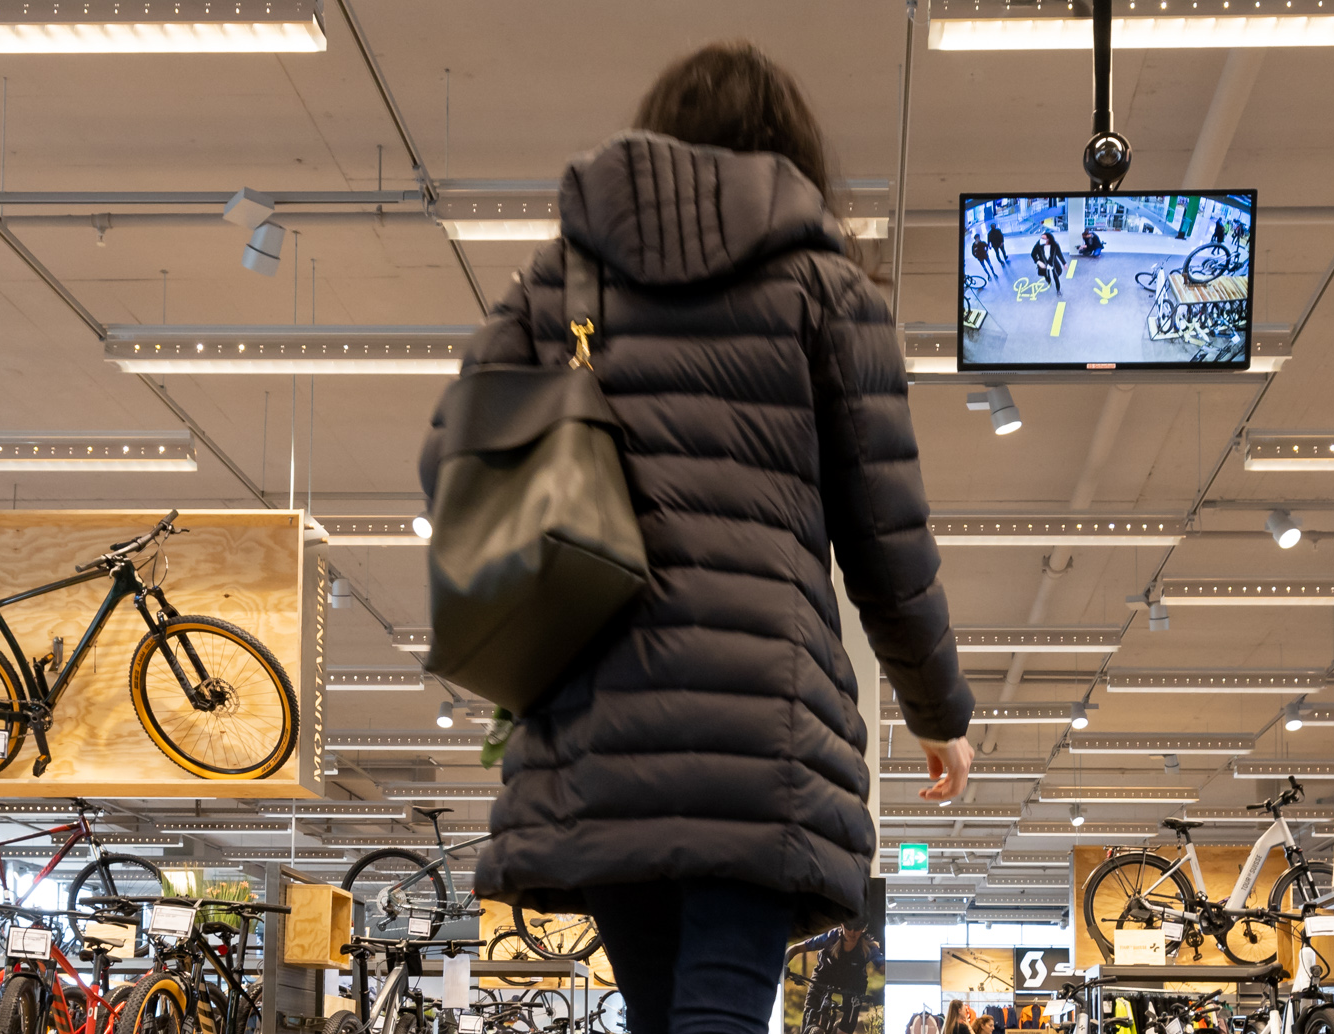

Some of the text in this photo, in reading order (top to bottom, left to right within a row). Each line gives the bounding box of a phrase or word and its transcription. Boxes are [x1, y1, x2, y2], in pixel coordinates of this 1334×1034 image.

[313, 553, 326, 783] MOUNTAINBIKE
[1240, 875, 1252, 892] TOUR
[1249, 853, 1264, 876] SUISSE
